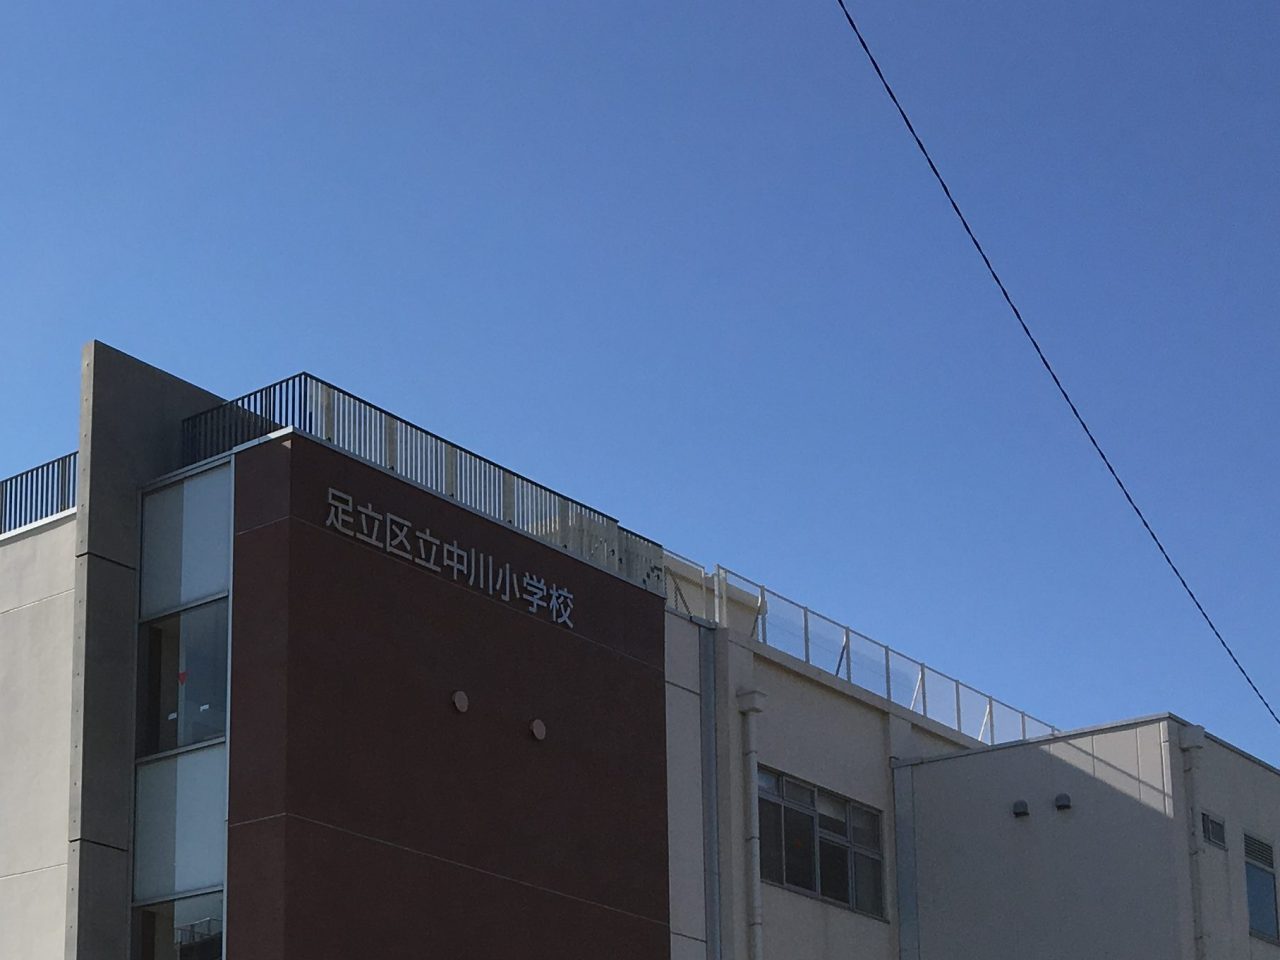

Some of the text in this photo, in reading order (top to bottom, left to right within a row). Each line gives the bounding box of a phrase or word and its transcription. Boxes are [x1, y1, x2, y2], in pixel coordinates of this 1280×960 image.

[325, 487, 574, 629] 足立区立中川小学校
